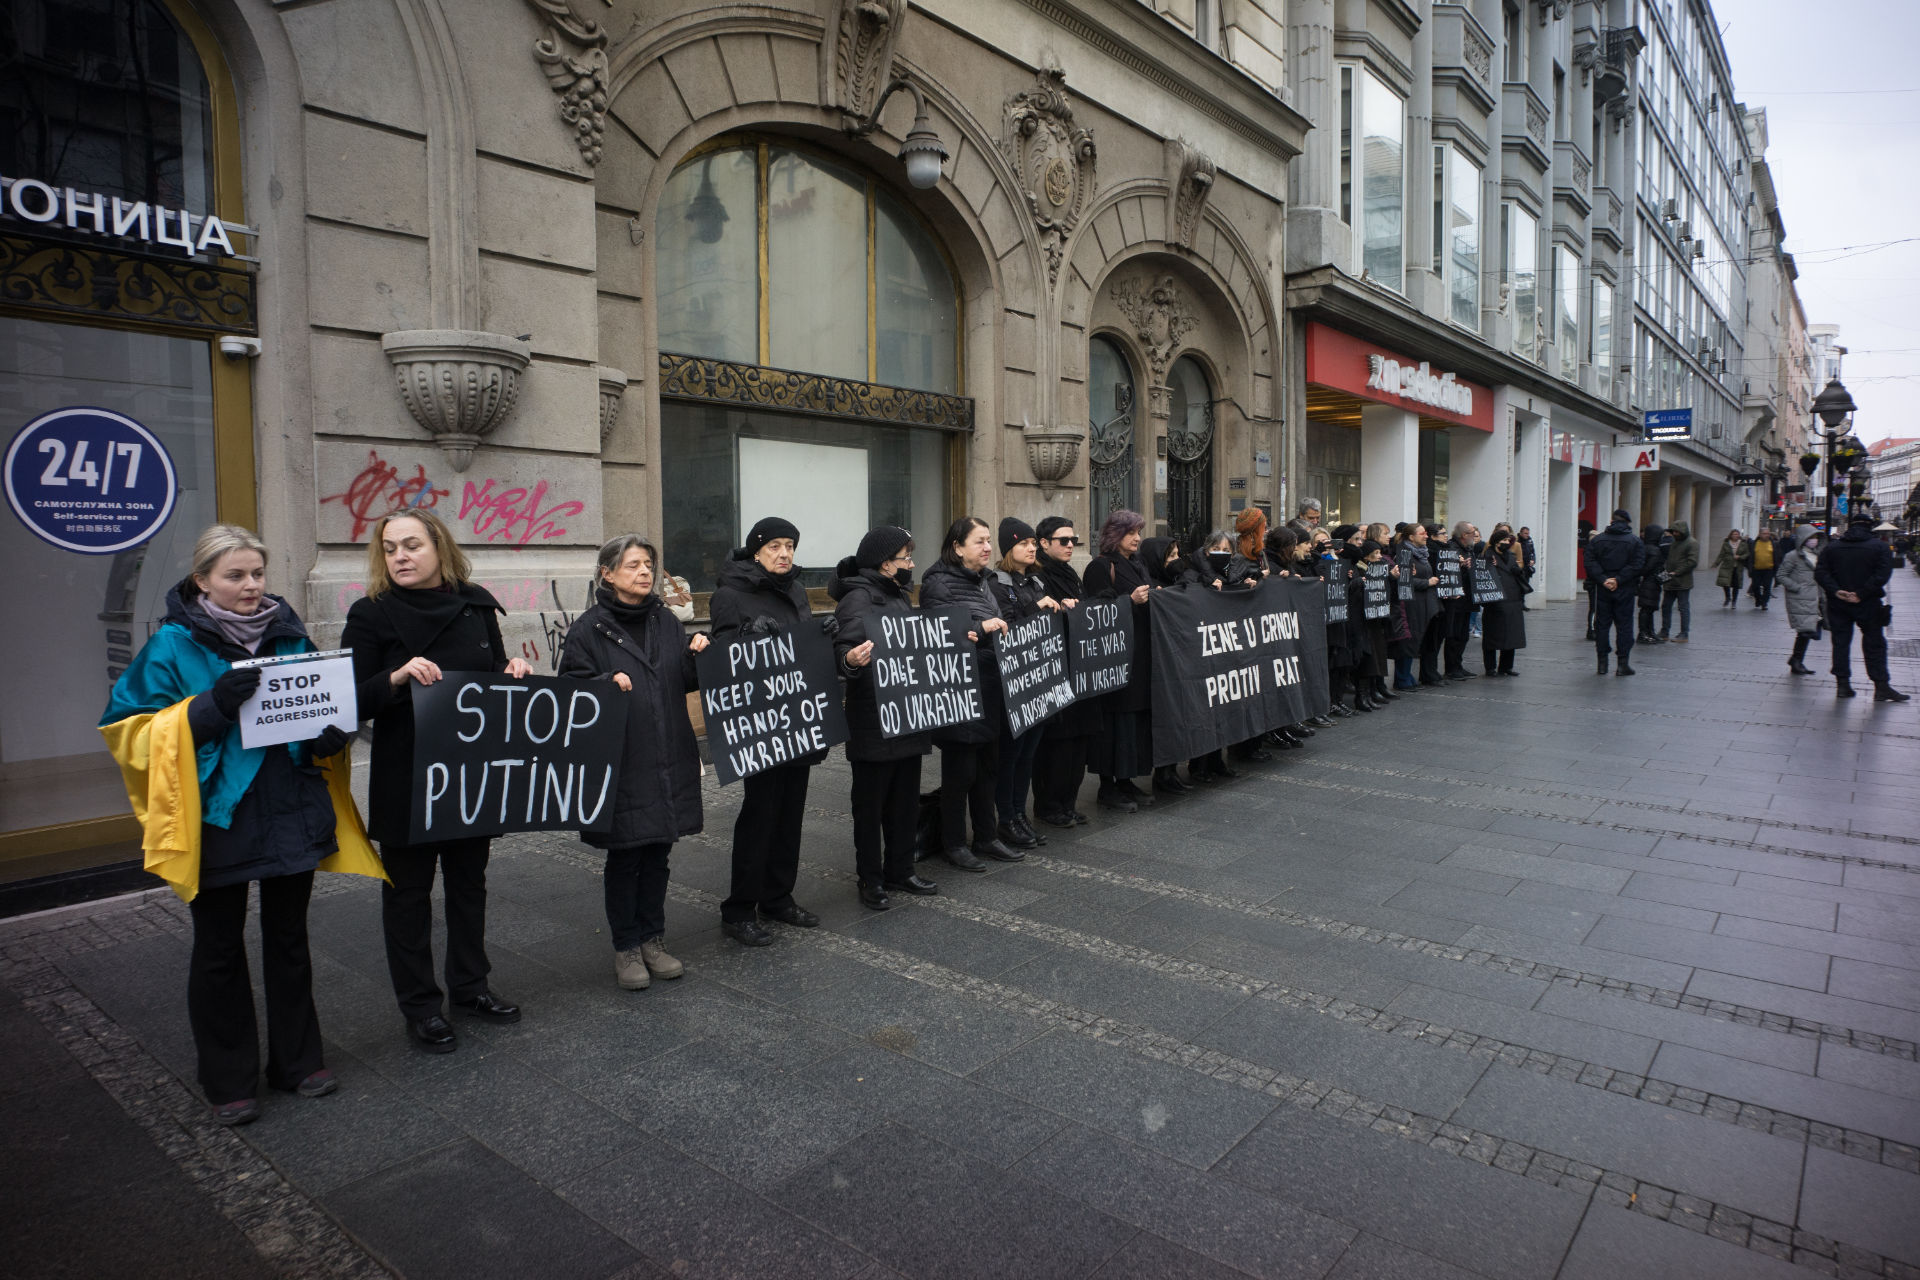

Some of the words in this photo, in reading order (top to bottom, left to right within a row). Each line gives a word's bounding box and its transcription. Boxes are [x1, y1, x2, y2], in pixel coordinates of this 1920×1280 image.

[0, 175, 236, 257] ОНИЦА
[38, 438, 143, 495] 24/7
[1635, 448, 1656, 469] A1
[34, 500, 122, 509] САМОУСЛУЖНА
[126, 502, 155, 510] ЗОНА
[53, 512, 114, 521] Self-service
[1085, 604, 1118, 631] STOP
[1243, 617, 1257, 649] U
[1000, 655, 1020, 676] WITH
[1022, 646, 1040, 666] THE
[1041, 634, 1064, 659] PEACE
[1079, 639, 1098, 659] THE
[1101, 630, 1127, 657] WAR
[268, 673, 322, 693] STOP
[925, 652, 974, 685] RUKE
[1007, 662, 1051, 699] MOVEMENT
[1092, 663, 1130, 691] UKRAINE
[260, 691, 331, 711] RUSSIAN
[705, 679, 755, 716] KEEP
[764, 669, 808, 701] YOUR
[1205, 664, 1261, 708] PROTIV
[256, 706, 339, 726] AGGRESSION
[456, 682, 601, 748] STOP
[722, 703, 792, 745] HANDS
[800, 691, 830, 723] OF
[880, 704, 902, 735] OD
[906, 688, 982, 729] UKRAJINE
